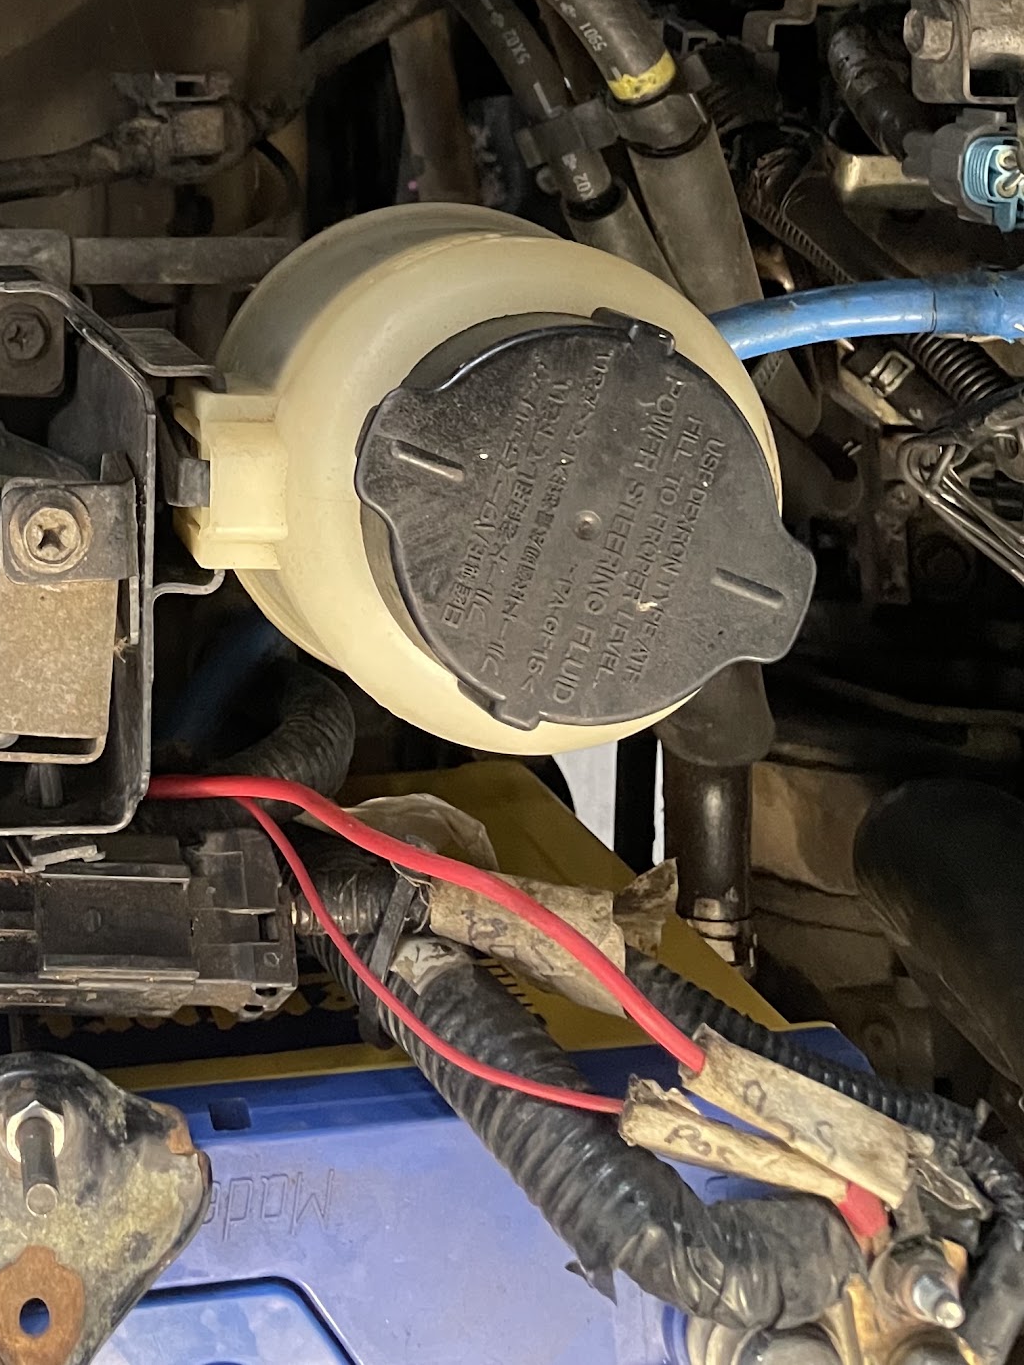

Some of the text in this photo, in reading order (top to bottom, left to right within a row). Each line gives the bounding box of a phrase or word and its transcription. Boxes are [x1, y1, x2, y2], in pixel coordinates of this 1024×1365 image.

[671, 415, 706, 466] FILL
[692, 435, 726, 486] USE
[656, 474, 683, 507] TO
[547, 374, 687, 706] POWER STEERING FLUID
[621, 510, 670, 604] PROPER
[659, 486, 708, 576] DEXRON
